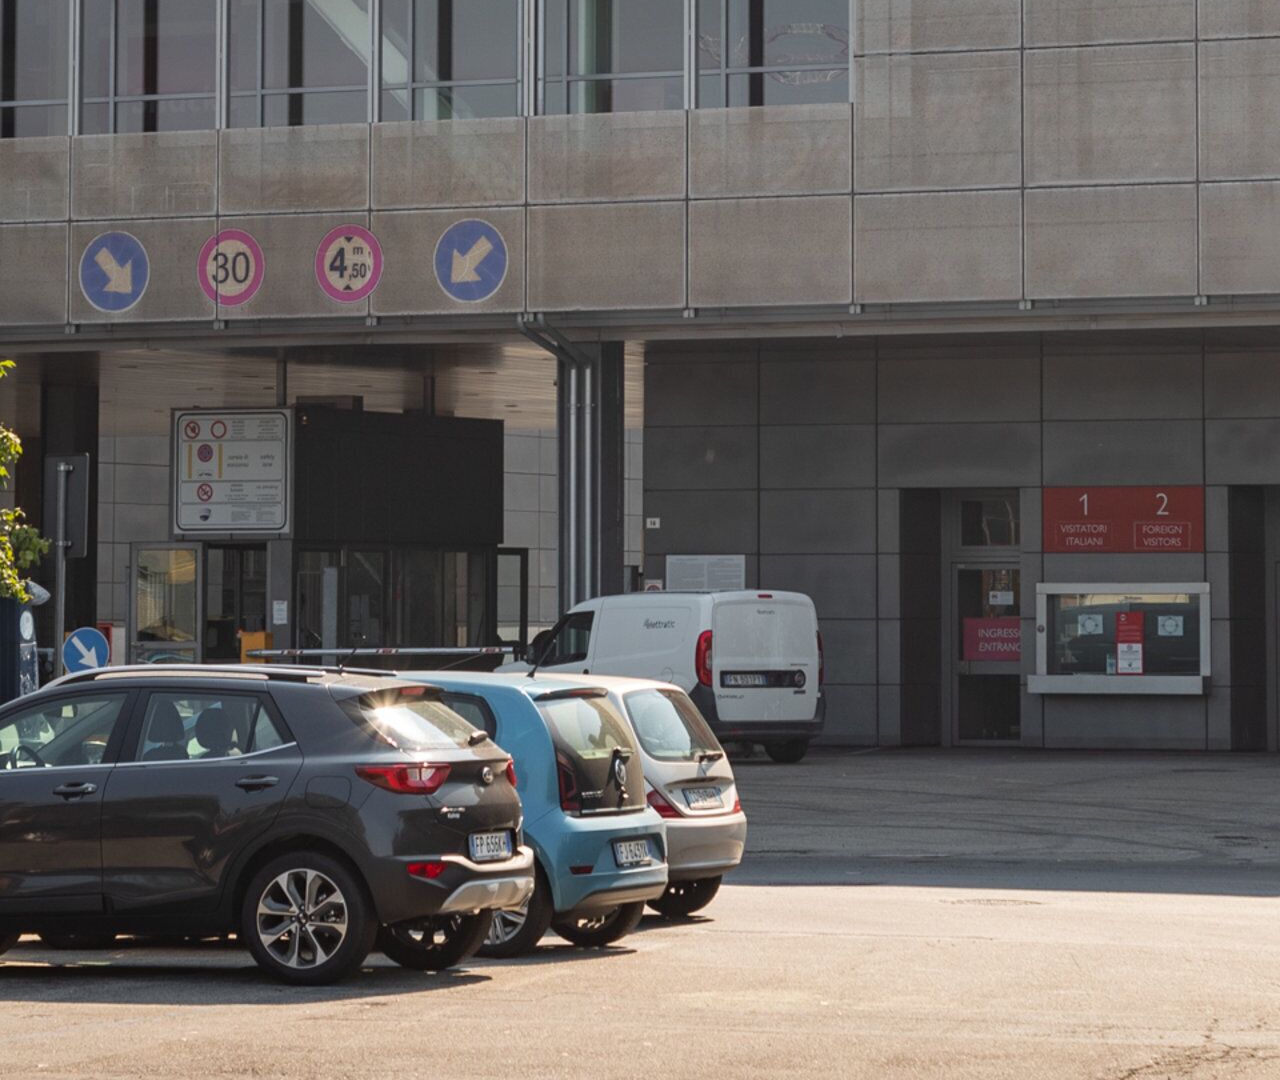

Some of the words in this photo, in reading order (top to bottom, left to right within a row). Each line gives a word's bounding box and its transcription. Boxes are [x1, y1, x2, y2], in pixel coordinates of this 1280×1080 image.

[211, 252, 251, 284] 30
[1078, 493, 1089, 516] 1
[1154, 492, 1169, 516] 2
[1060, 524, 1107, 533] VISITATORI
[1142, 525, 1183, 534] FOREIGN
[1066, 537, 1103, 546] ITALIANI
[1143, 538, 1182, 547] VISITORS
[977, 628, 1021, 638] INGRESS
[978, 642, 1021, 652] ENTRANC
